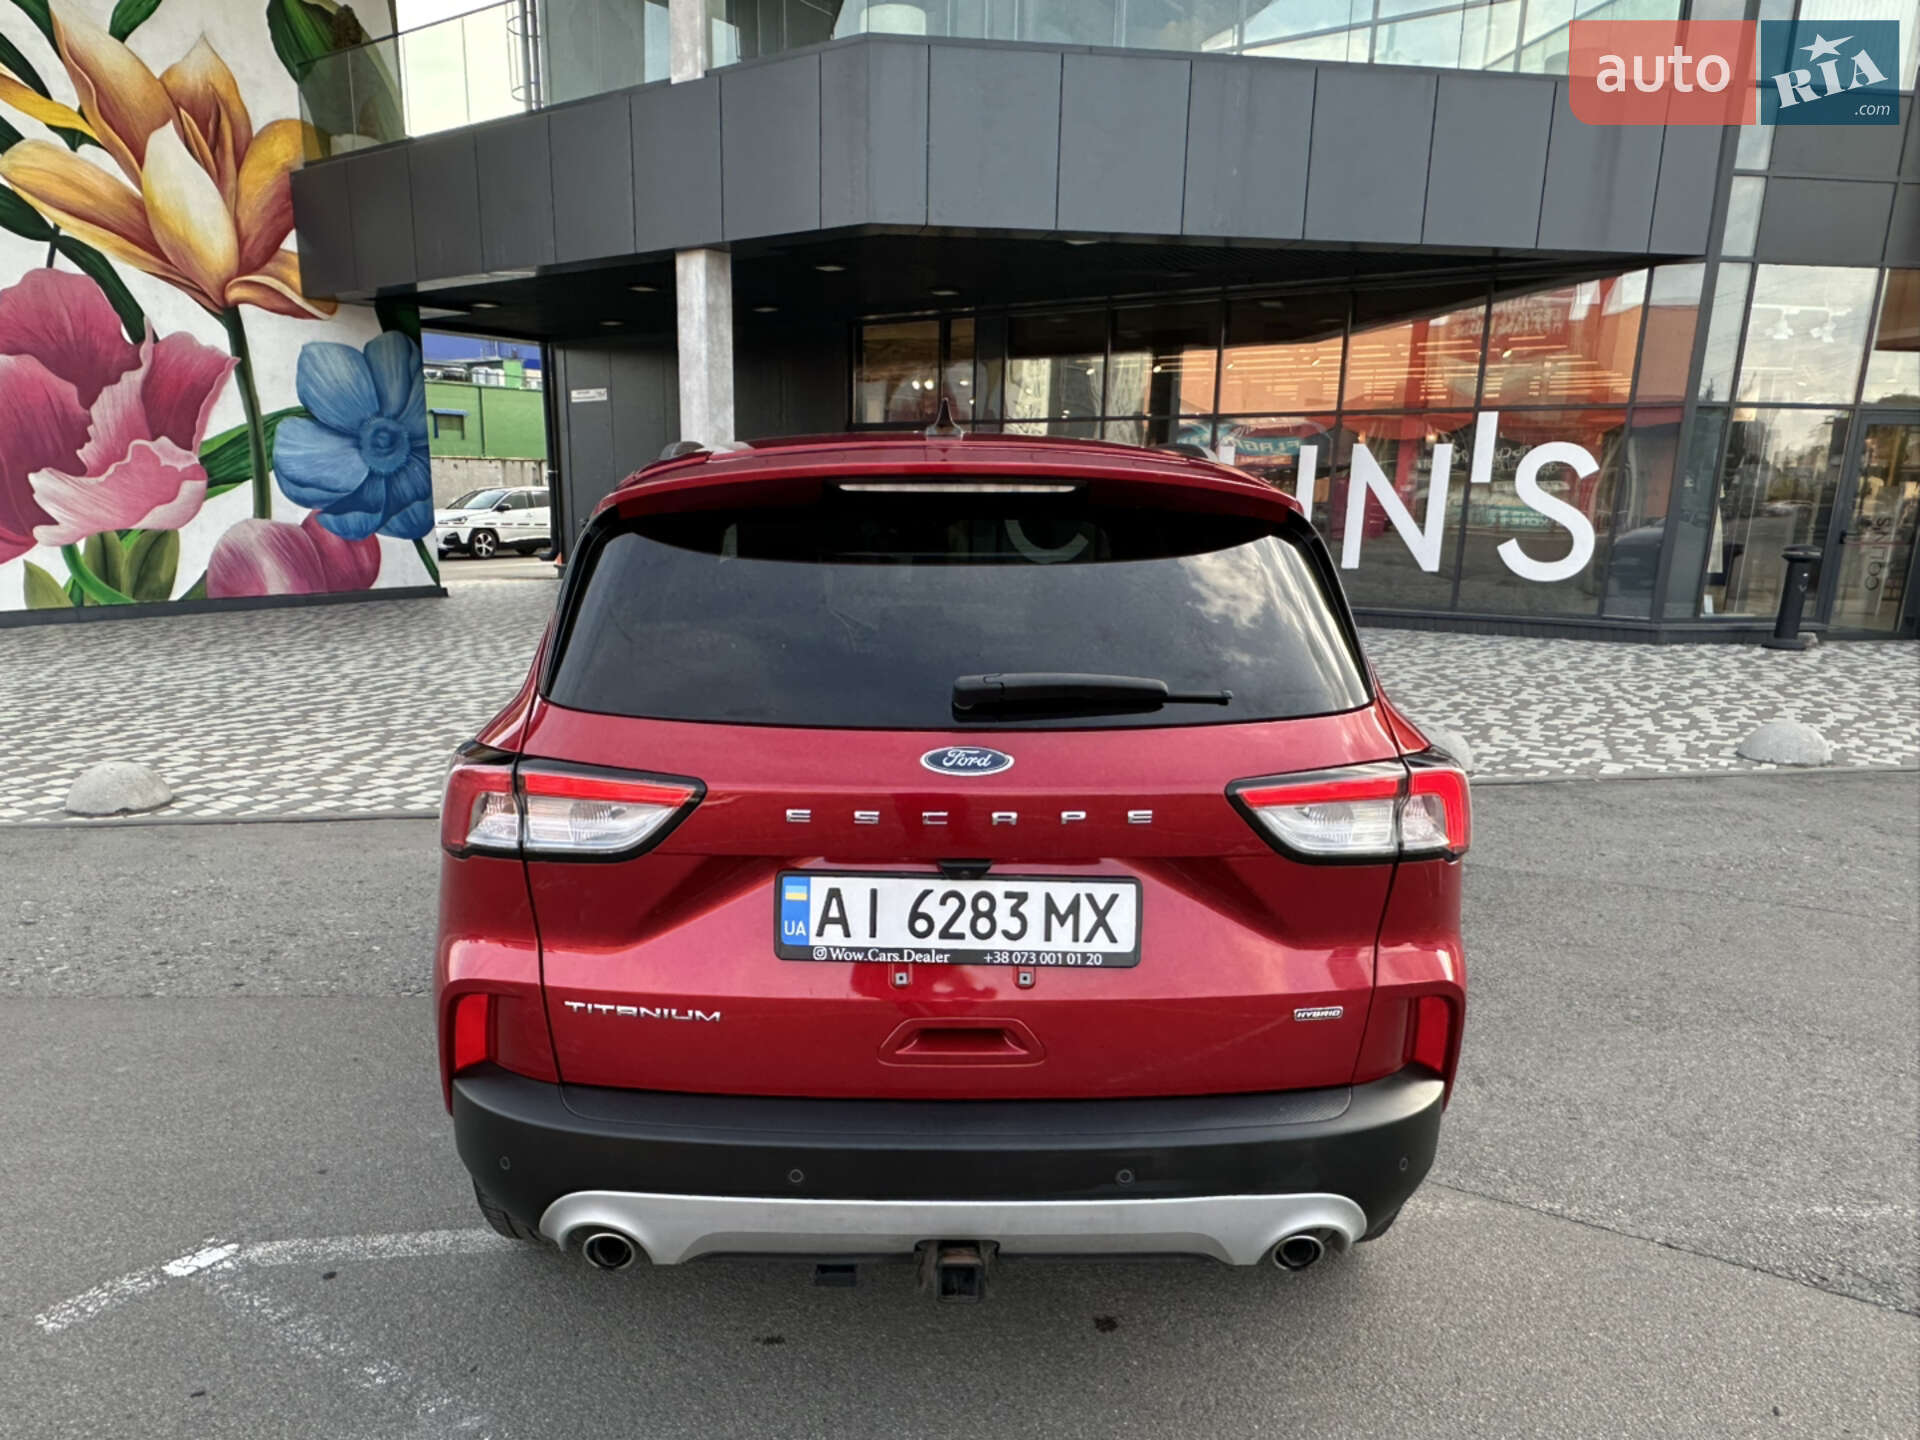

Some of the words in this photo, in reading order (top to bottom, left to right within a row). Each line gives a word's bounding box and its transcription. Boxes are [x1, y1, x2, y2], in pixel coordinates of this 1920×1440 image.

[1218, 411, 1600, 582] IN'S
[942, 748, 993, 767] Ford
[786, 808, 1153, 826] ESCAPE
[815, 887, 878, 939] AI
[907, 888, 1029, 942] 6283
[1043, 891, 1120, 944] MX
[784, 919, 807, 936] UA
[983, 951, 1009, 964] +38
[1012, 951, 1037, 965] 073
[1039, 952, 1062, 965] 001
[1066, 953, 1081, 965] 01
[1086, 953, 1103, 966] 20
[564, 1000, 721, 1022] TITANIUM
